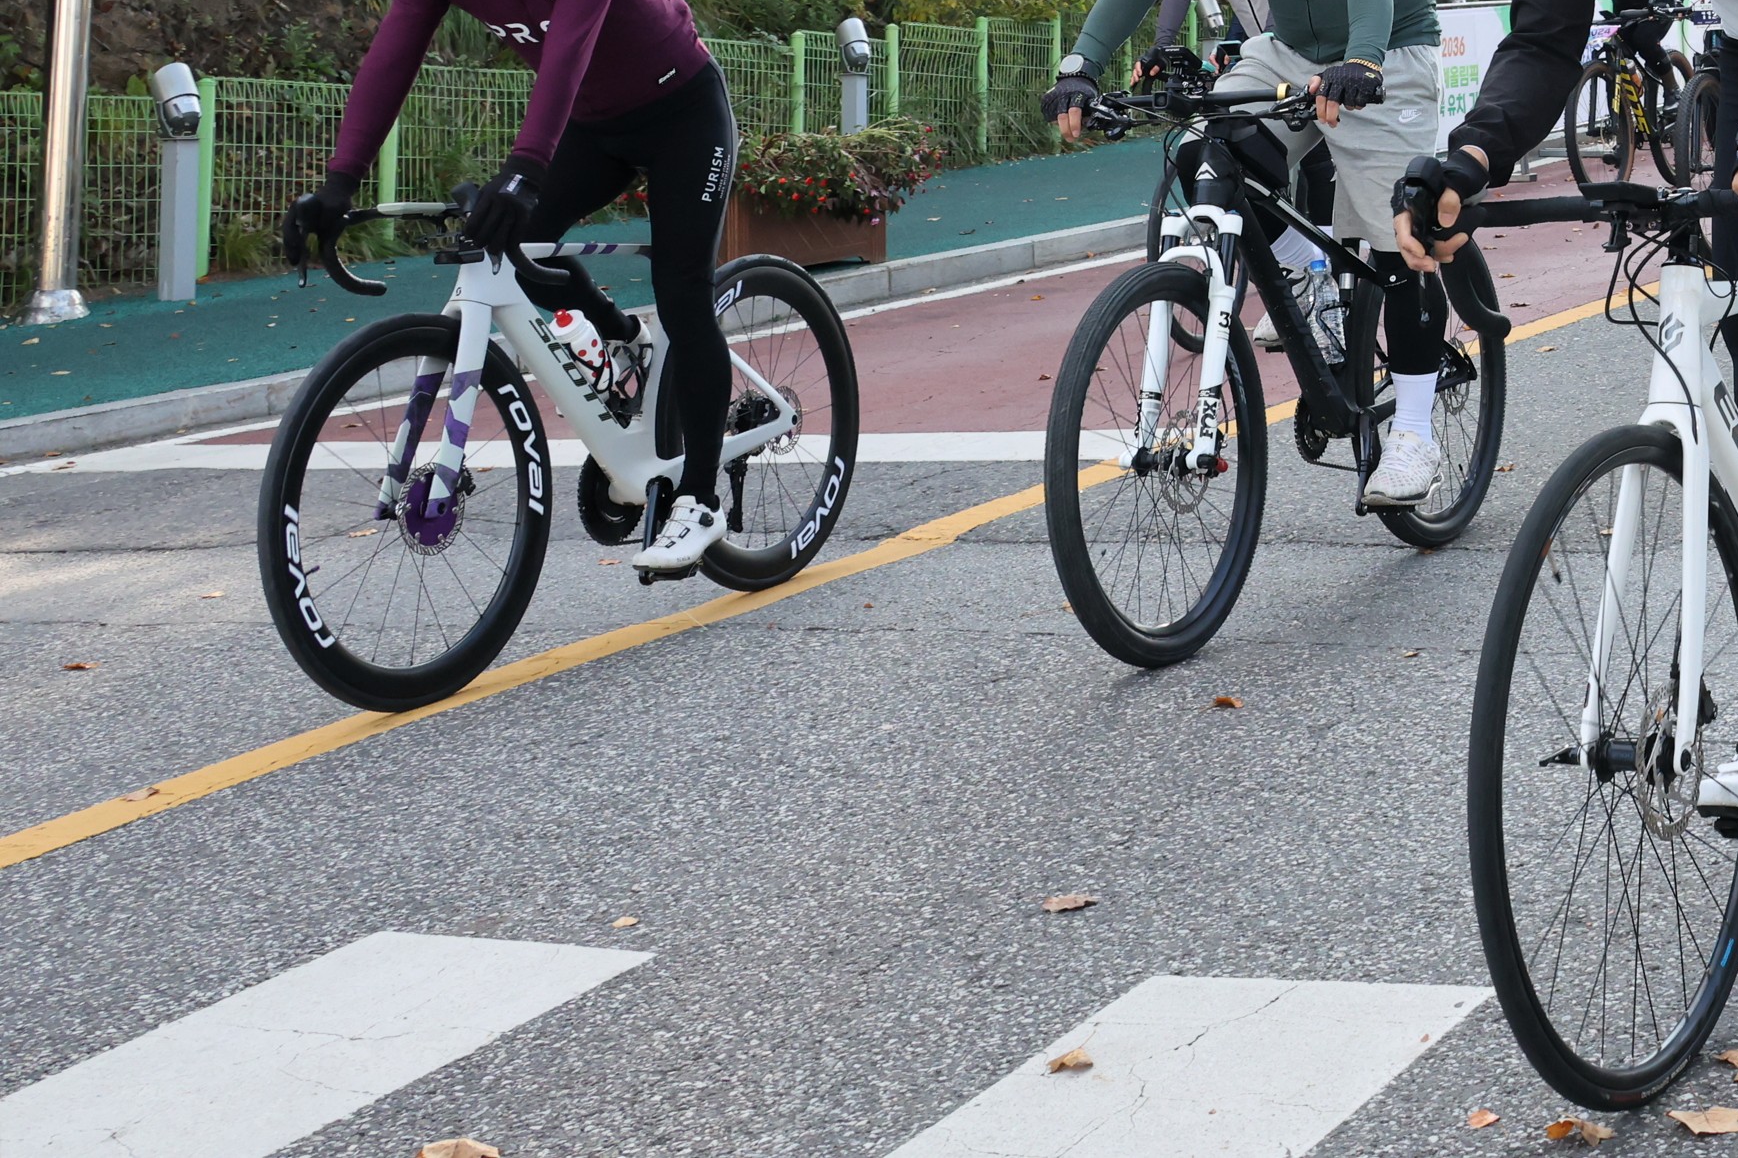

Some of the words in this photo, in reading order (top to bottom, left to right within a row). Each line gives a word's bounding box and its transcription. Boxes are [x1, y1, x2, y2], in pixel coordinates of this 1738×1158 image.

[1442, 36, 1466, 58] 2036
[1448, 93, 1467, 117] 유치
[701, 146, 724, 203] PURISM
[529, 317, 620, 425] SCOTT
[498, 383, 545, 516] roval
[1199, 400, 1218, 440] FOX
[791, 455, 845, 560] roval
[284, 503, 336, 650] roval
